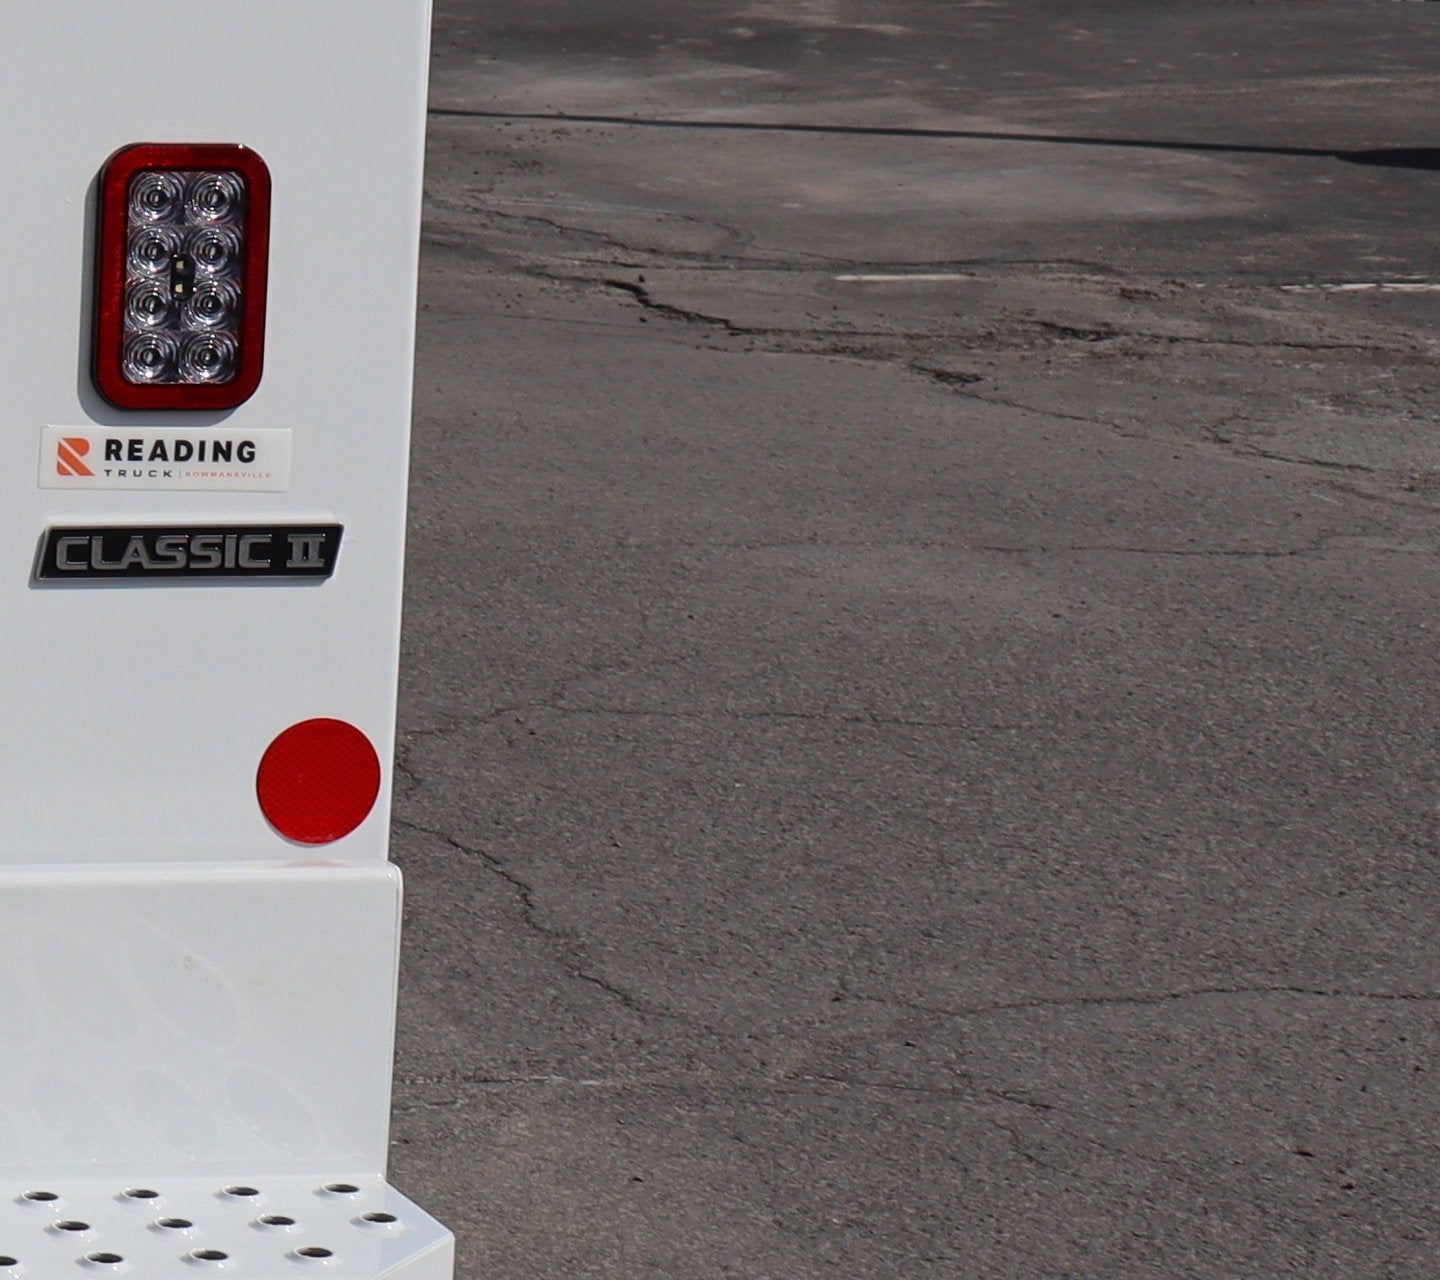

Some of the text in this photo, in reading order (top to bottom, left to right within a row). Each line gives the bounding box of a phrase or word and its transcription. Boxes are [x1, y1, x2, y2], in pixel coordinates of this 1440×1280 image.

[104, 438, 257, 464] READING
[103, 469, 173, 478] TRUCK
[55, 533, 326, 571] CLASSIC II
